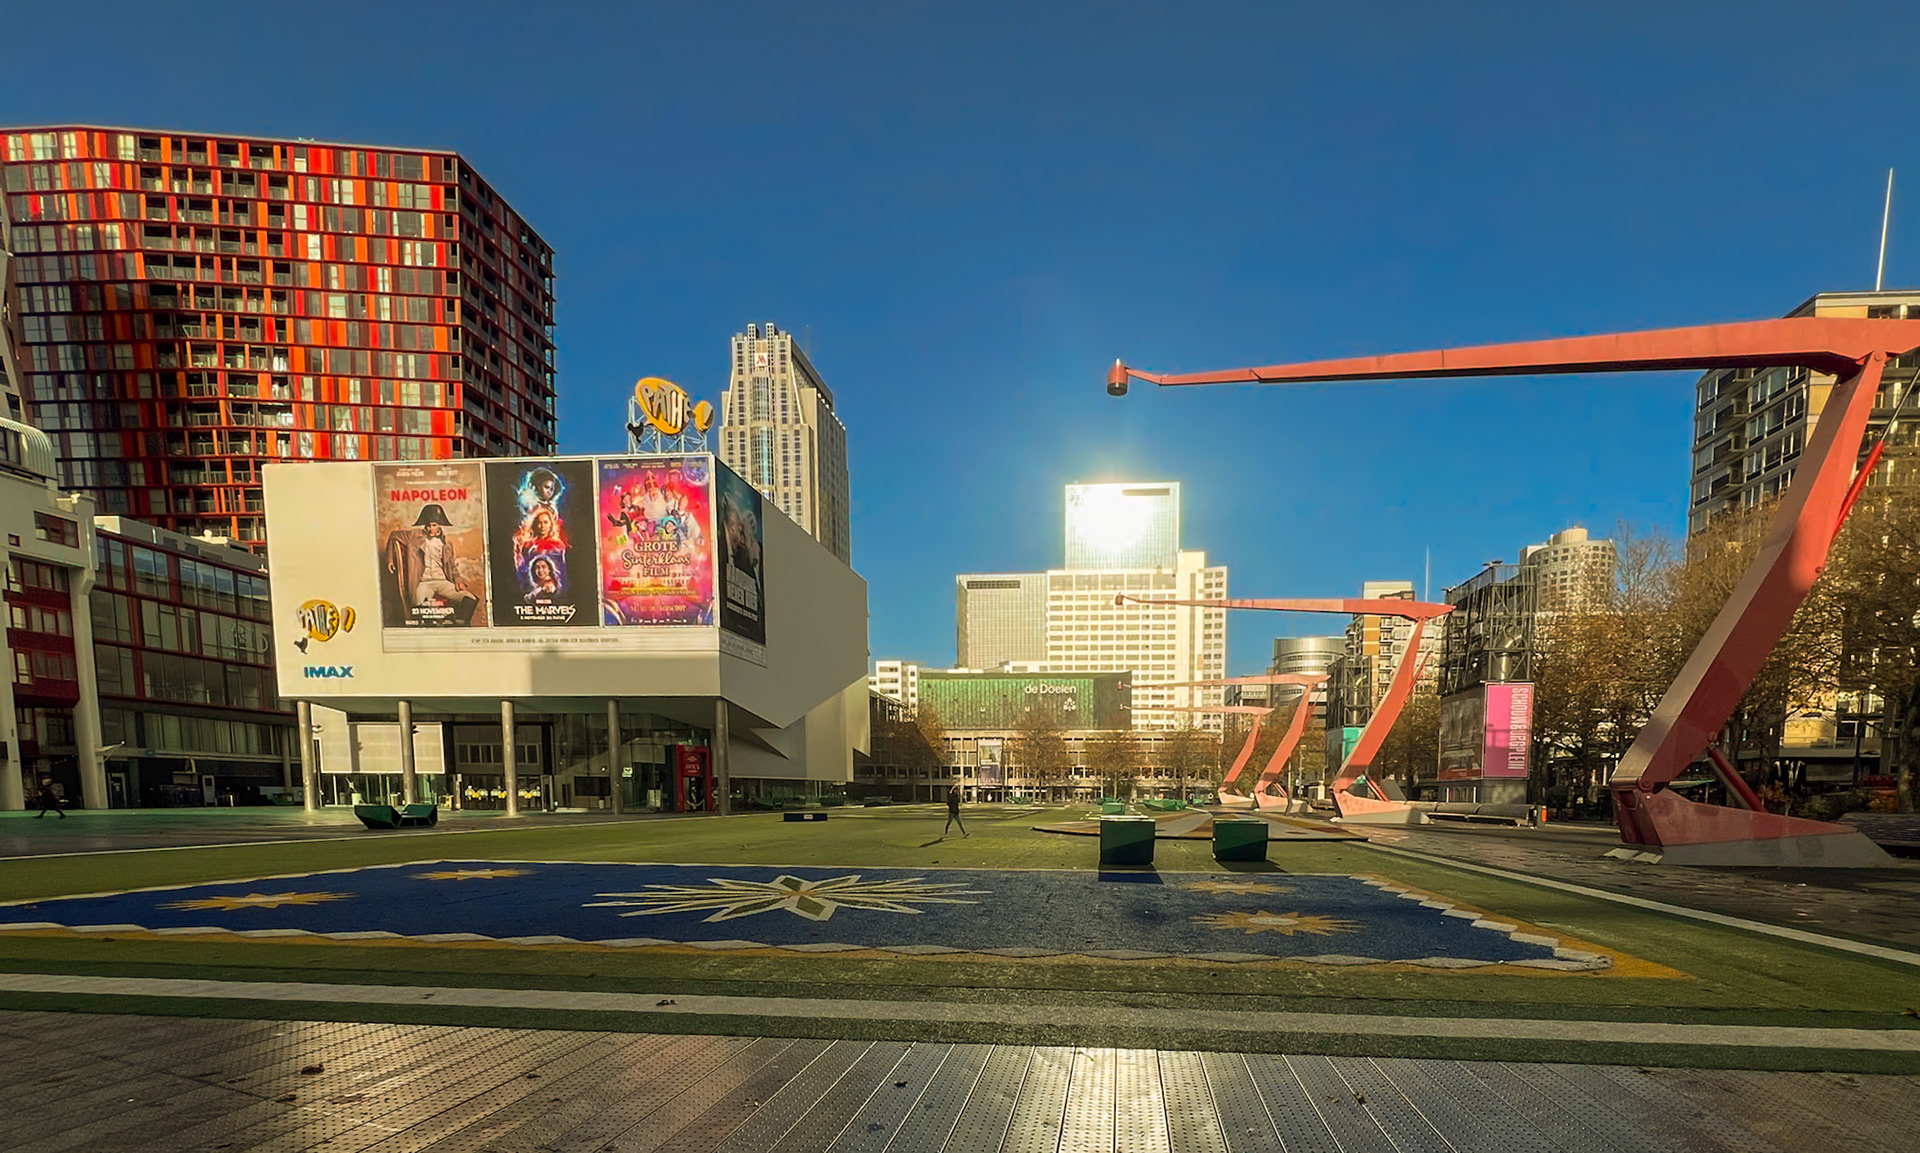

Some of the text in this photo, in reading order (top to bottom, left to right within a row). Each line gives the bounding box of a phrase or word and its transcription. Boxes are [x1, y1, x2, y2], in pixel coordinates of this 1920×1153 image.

[391, 489, 467, 501] NAPOLEON
[634, 541, 678, 552] GROTE
[622, 549, 690, 570] Sinterklaas
[642, 567, 669, 577] FILM
[420, 607, 455, 615] NOVEMBER
[514, 604, 576, 623] THE MARVELS
[304, 666, 354, 678] IMAX
[1024, 684, 1076, 694] de Doelen
[1508, 687, 1528, 769] SCHOUWBURGPLEIN
